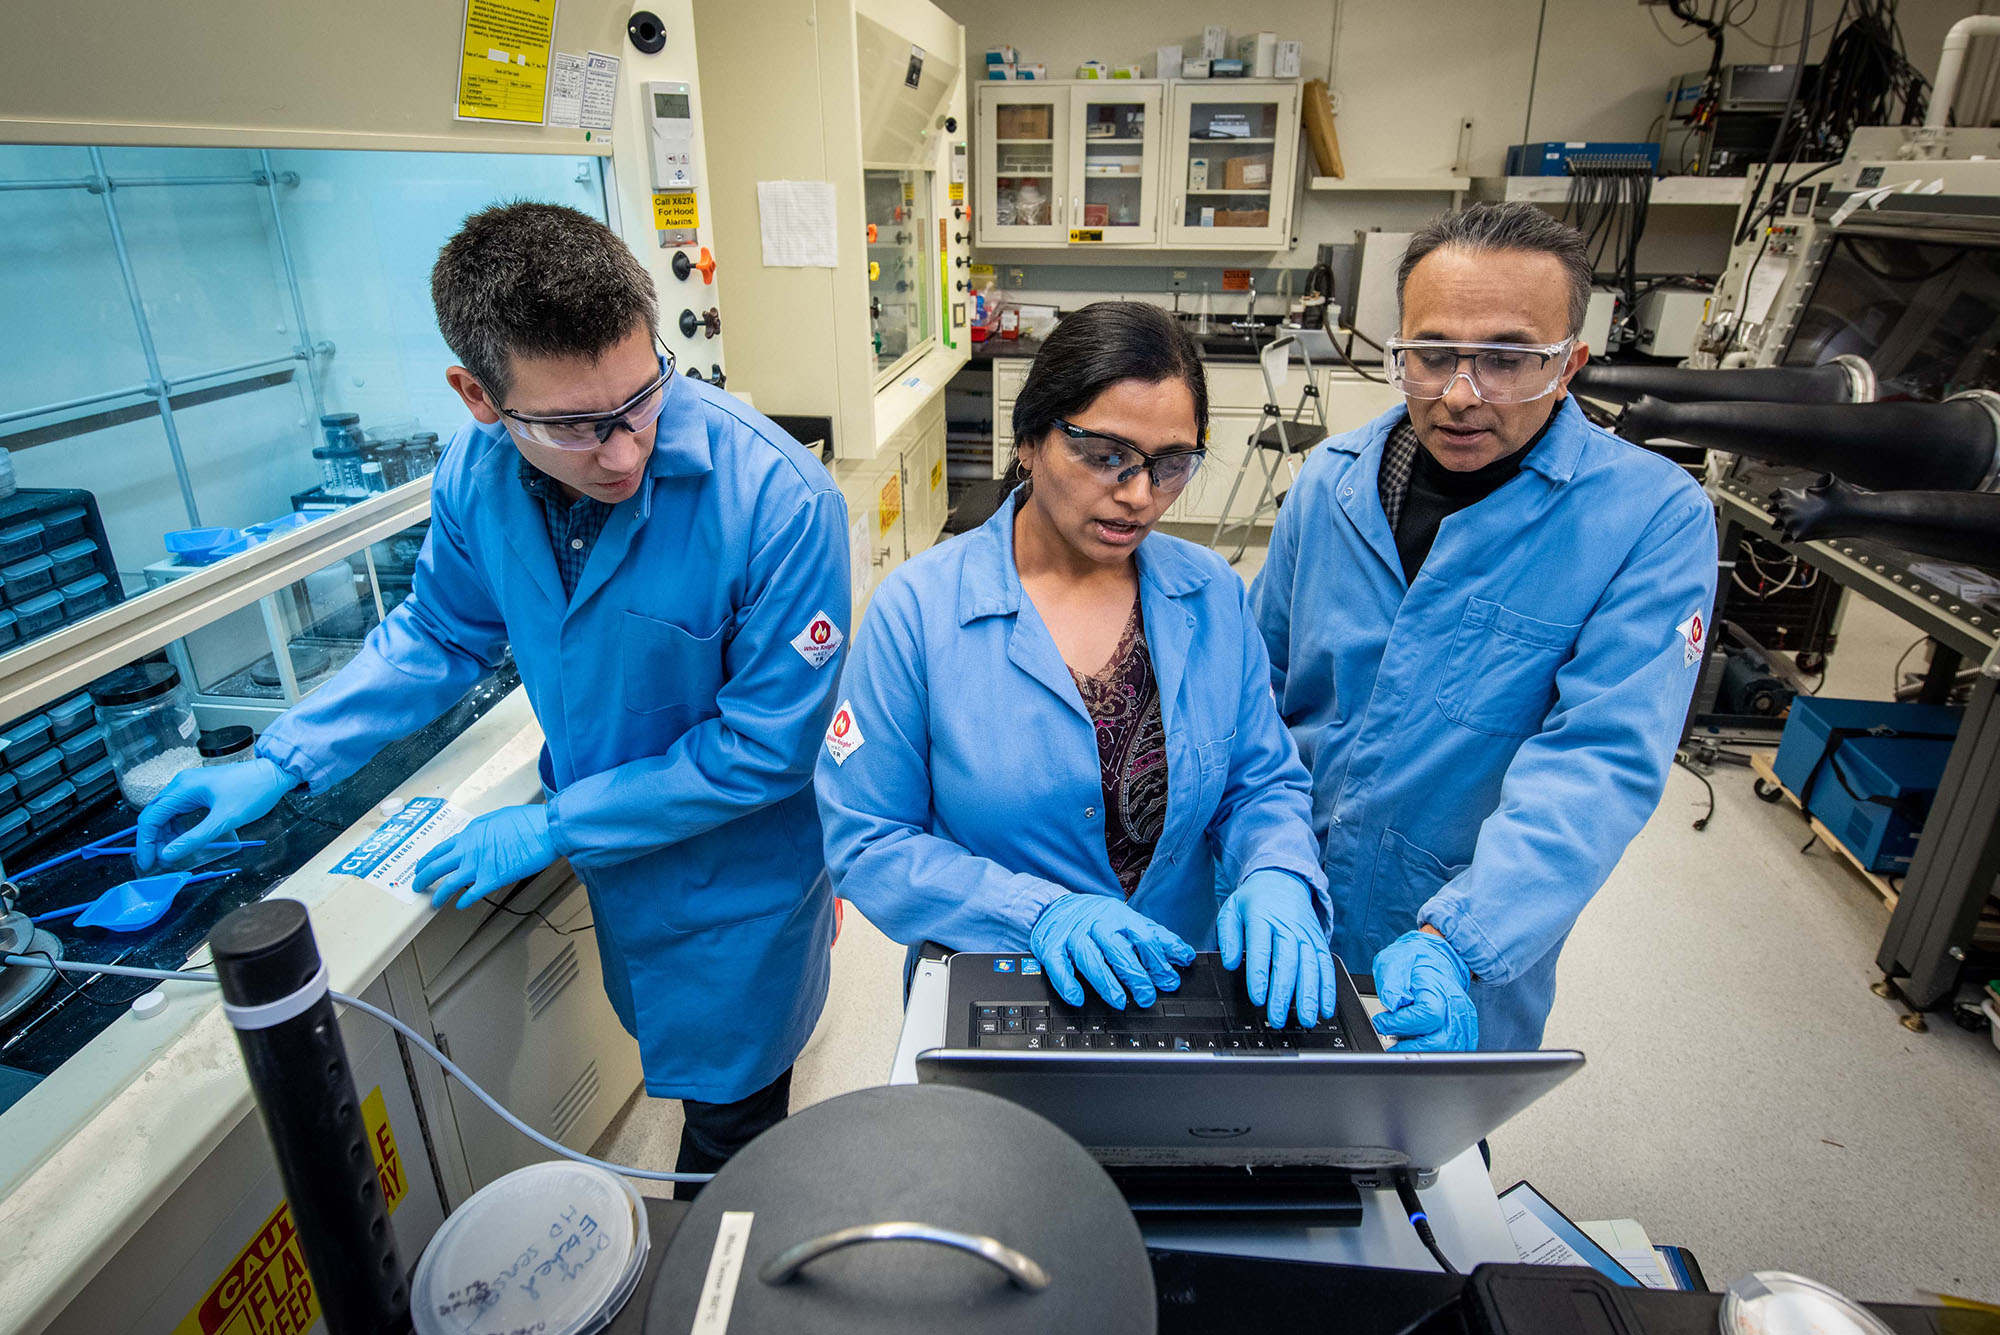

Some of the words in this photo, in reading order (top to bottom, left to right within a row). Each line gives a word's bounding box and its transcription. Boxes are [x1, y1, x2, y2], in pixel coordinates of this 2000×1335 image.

[342, 824, 405, 871] CLOSE
[398, 800, 431, 821] ME
[373, 862, 392, 880] SAVE
[390, 840, 417, 863] ENERGY
[420, 821, 438, 837] STAY
[218, 1216, 296, 1310] CAUT
